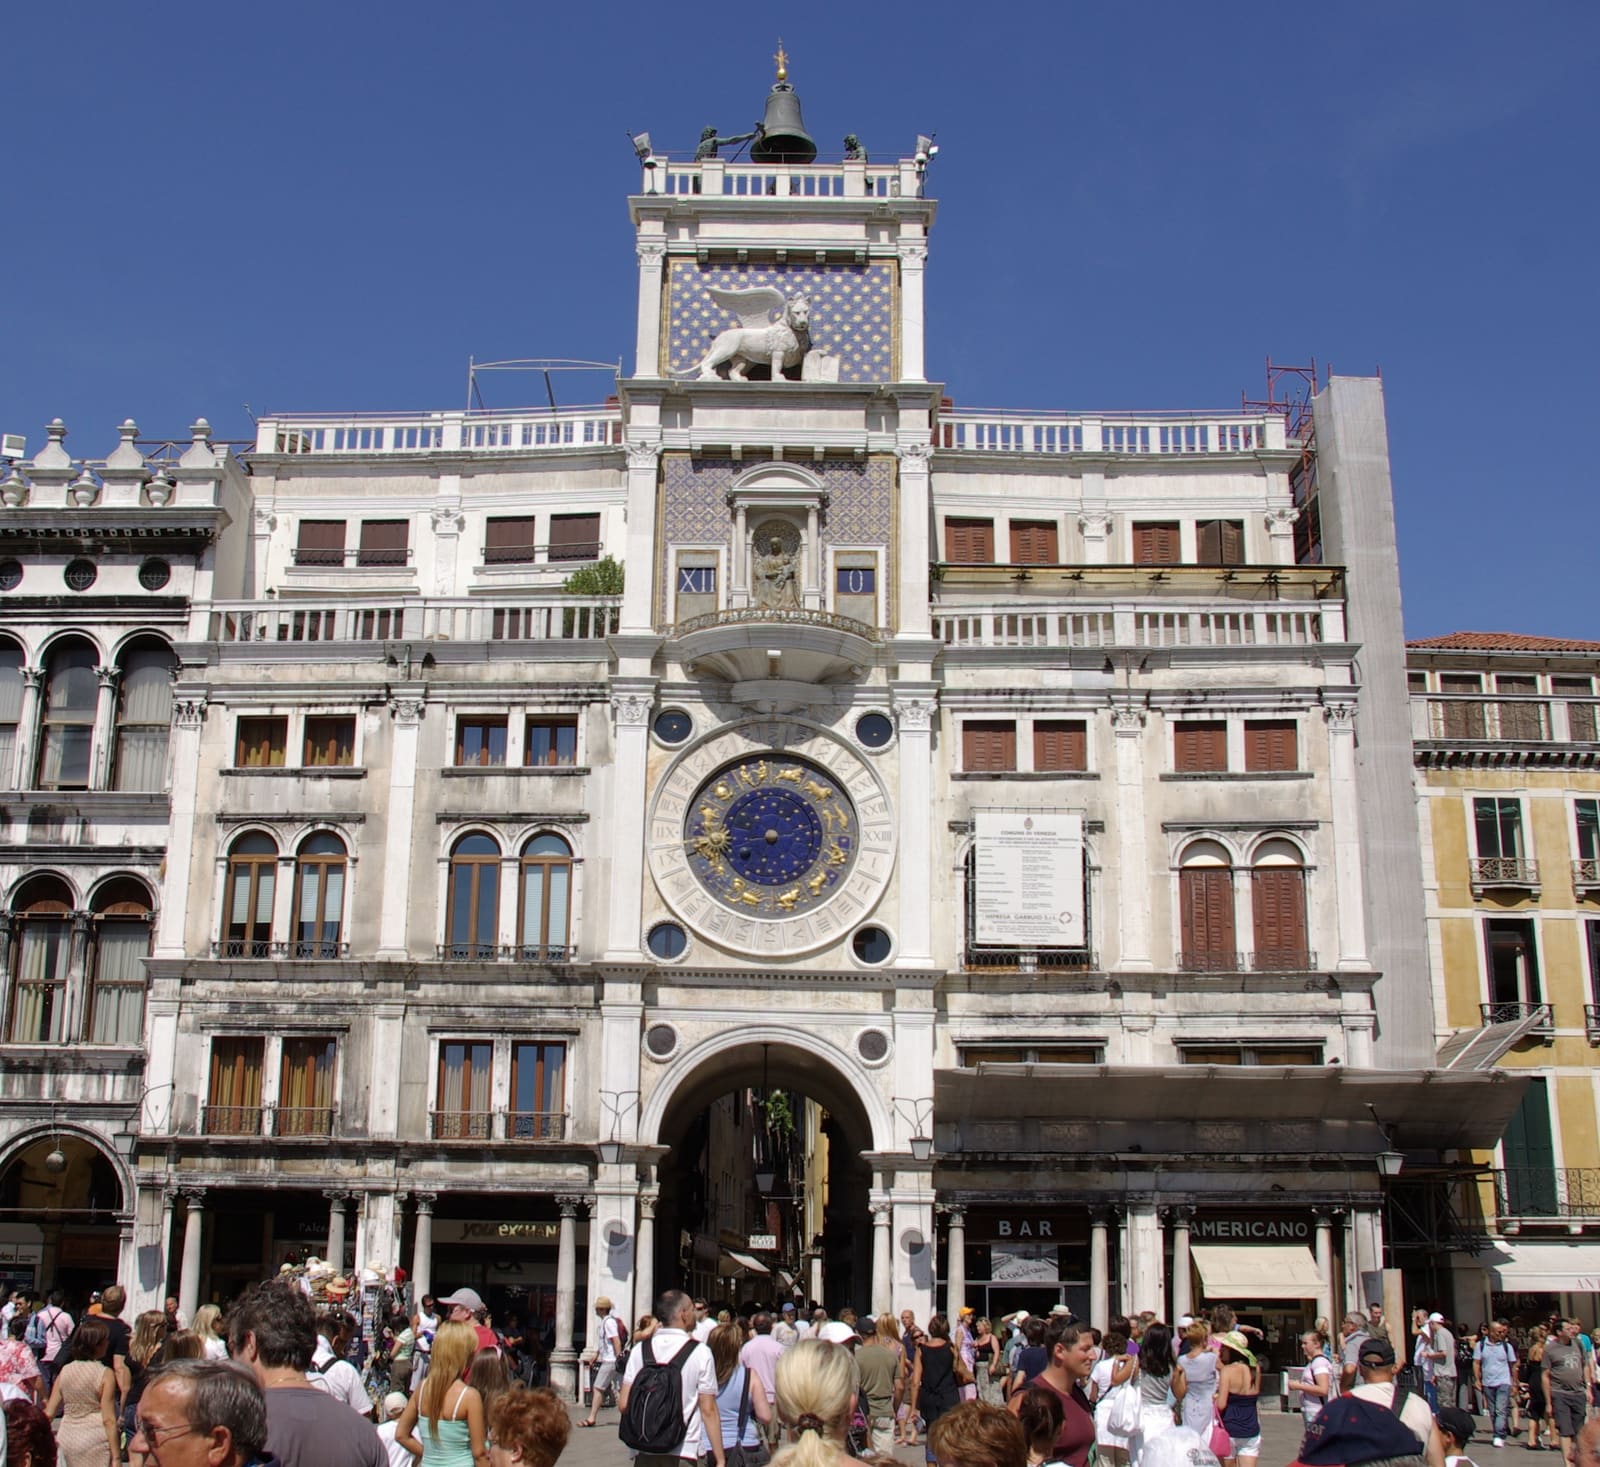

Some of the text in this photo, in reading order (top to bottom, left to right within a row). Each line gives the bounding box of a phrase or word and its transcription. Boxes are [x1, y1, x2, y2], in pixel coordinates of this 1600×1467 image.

[680, 568, 715, 593] XII
[999, 1220, 1053, 1236] BAR
[1189, 1221, 1308, 1237] AMERICANO
